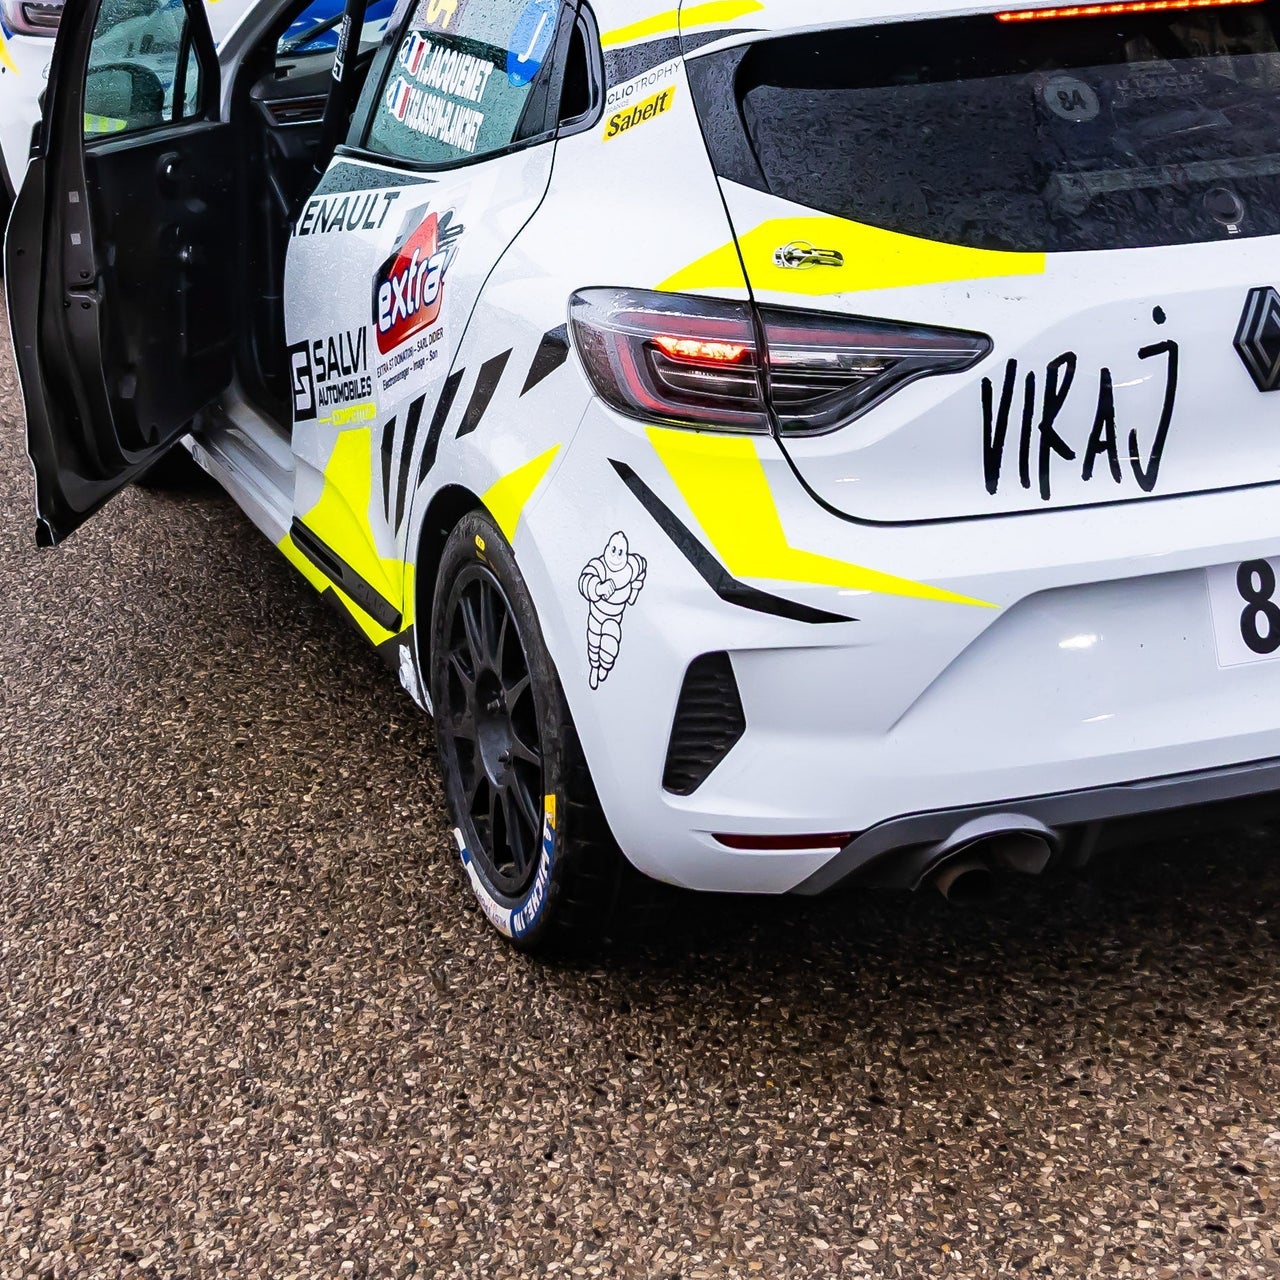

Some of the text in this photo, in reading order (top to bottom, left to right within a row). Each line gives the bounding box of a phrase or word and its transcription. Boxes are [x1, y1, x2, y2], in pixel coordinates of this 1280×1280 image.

[517, 11, 548, 64] J
[607, 91, 669, 137] Sabelt
[292, 191, 401, 237] ENAULT
[378, 246, 450, 335] extra
[313, 325, 367, 383] SALVI
[318, 375, 372, 408] AUTOMOBILES
